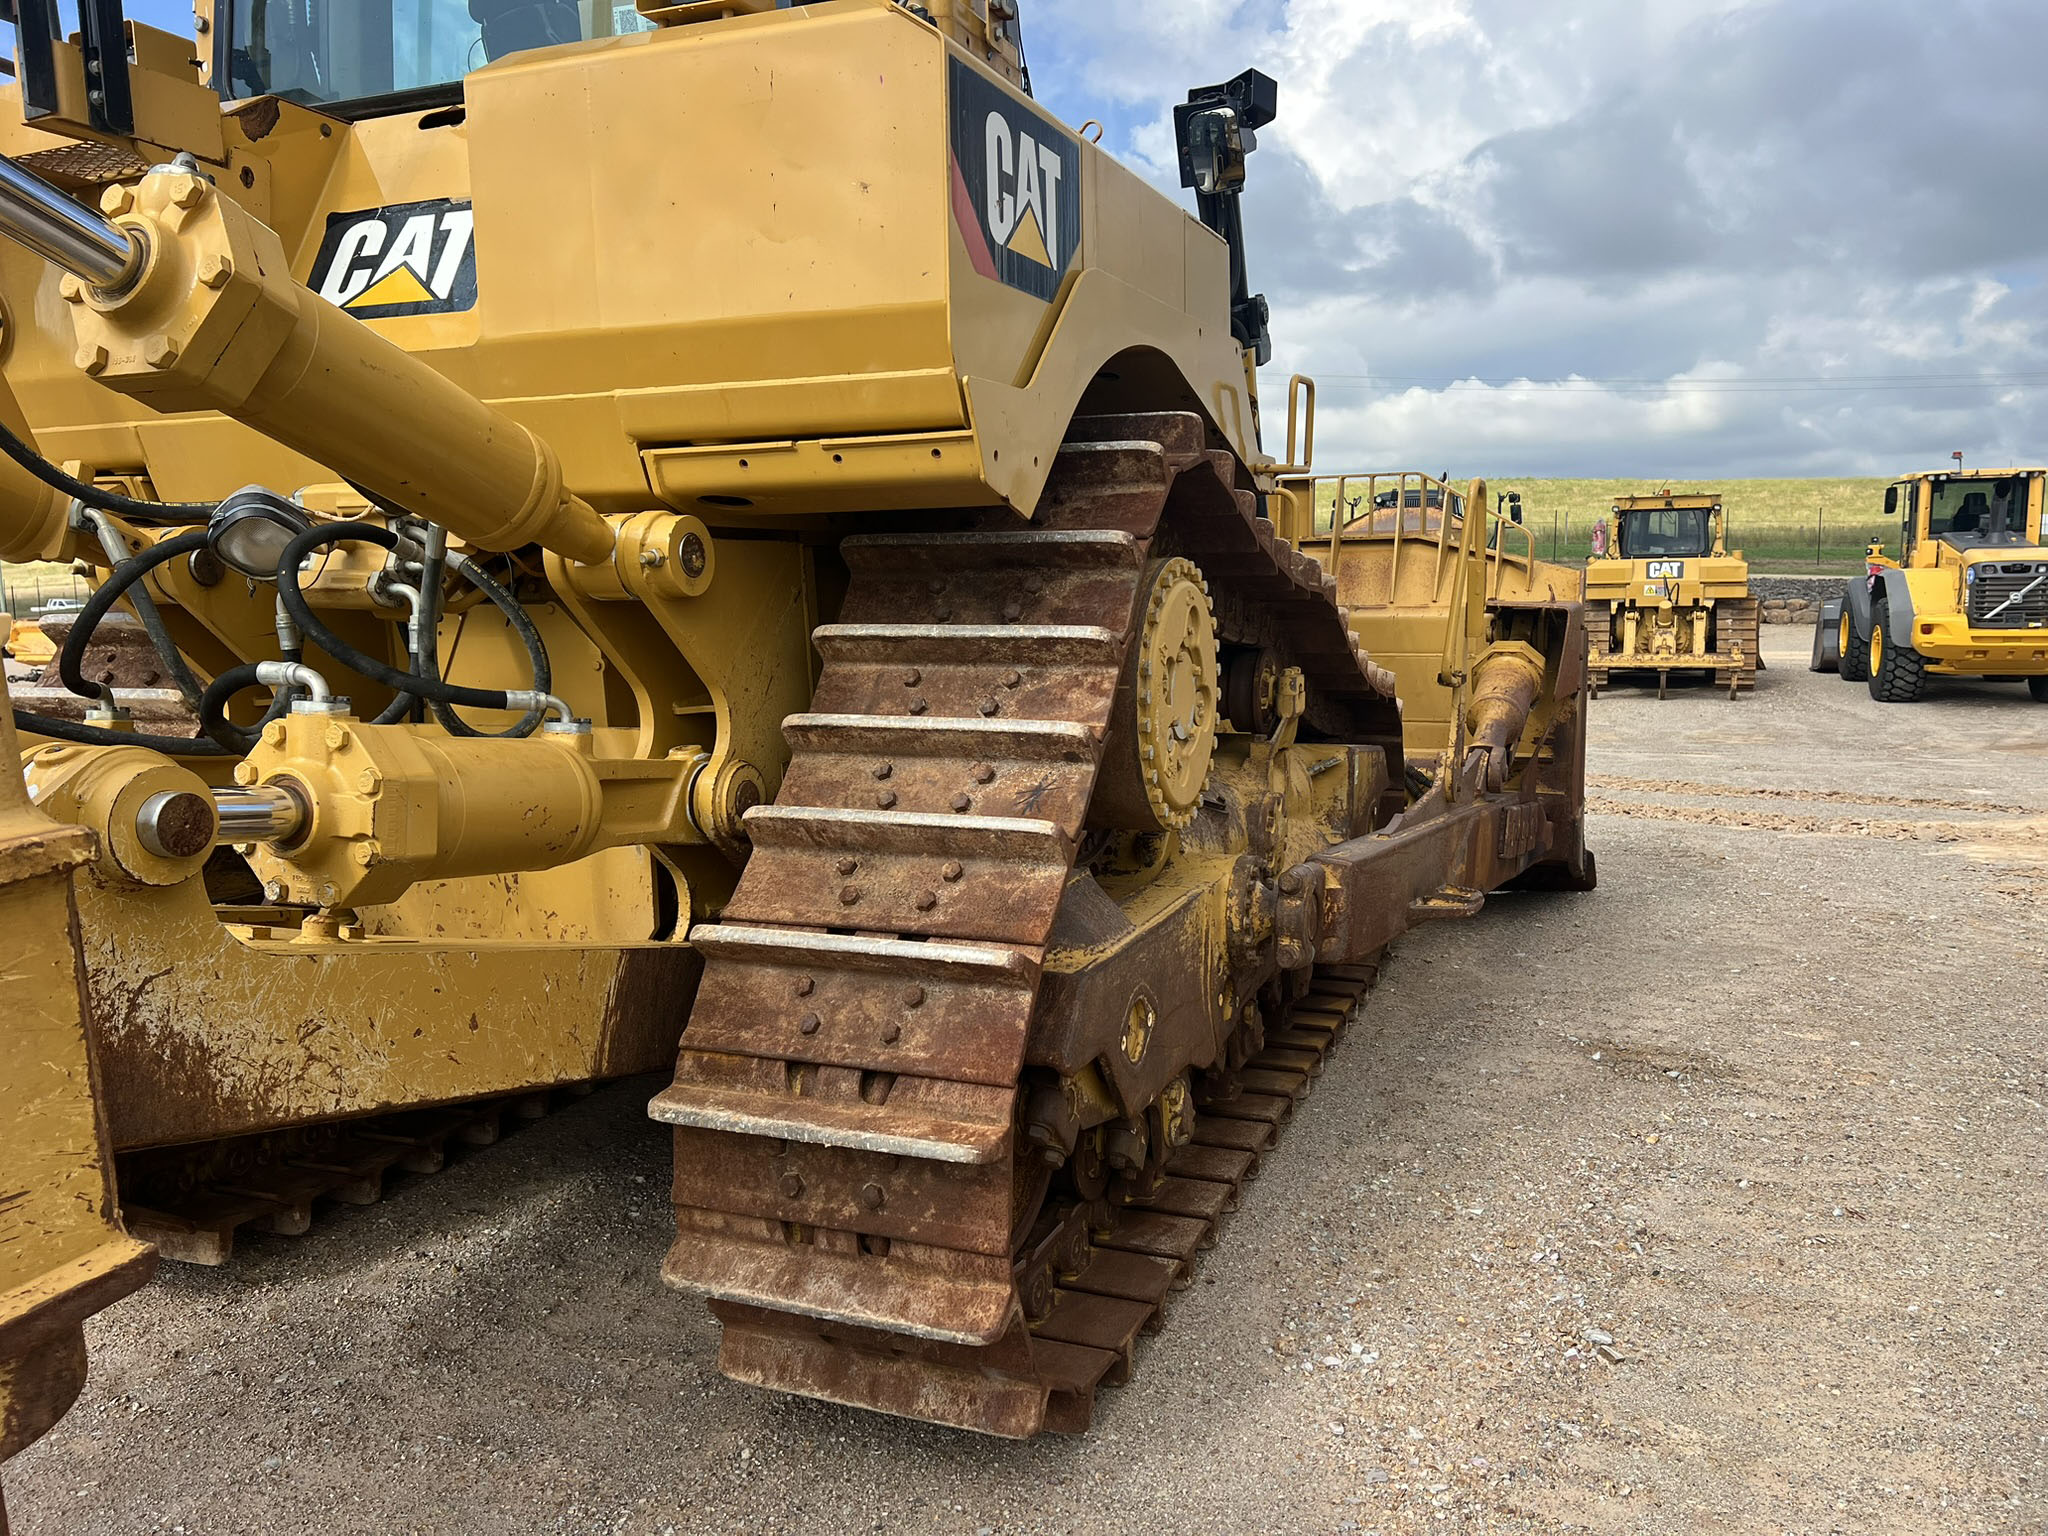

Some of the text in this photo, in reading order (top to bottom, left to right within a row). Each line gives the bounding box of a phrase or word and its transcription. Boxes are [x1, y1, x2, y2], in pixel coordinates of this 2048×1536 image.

[986, 111, 1061, 271] CAT
[319, 209, 474, 307] CAT
[1649, 561, 1680, 578] CAT
